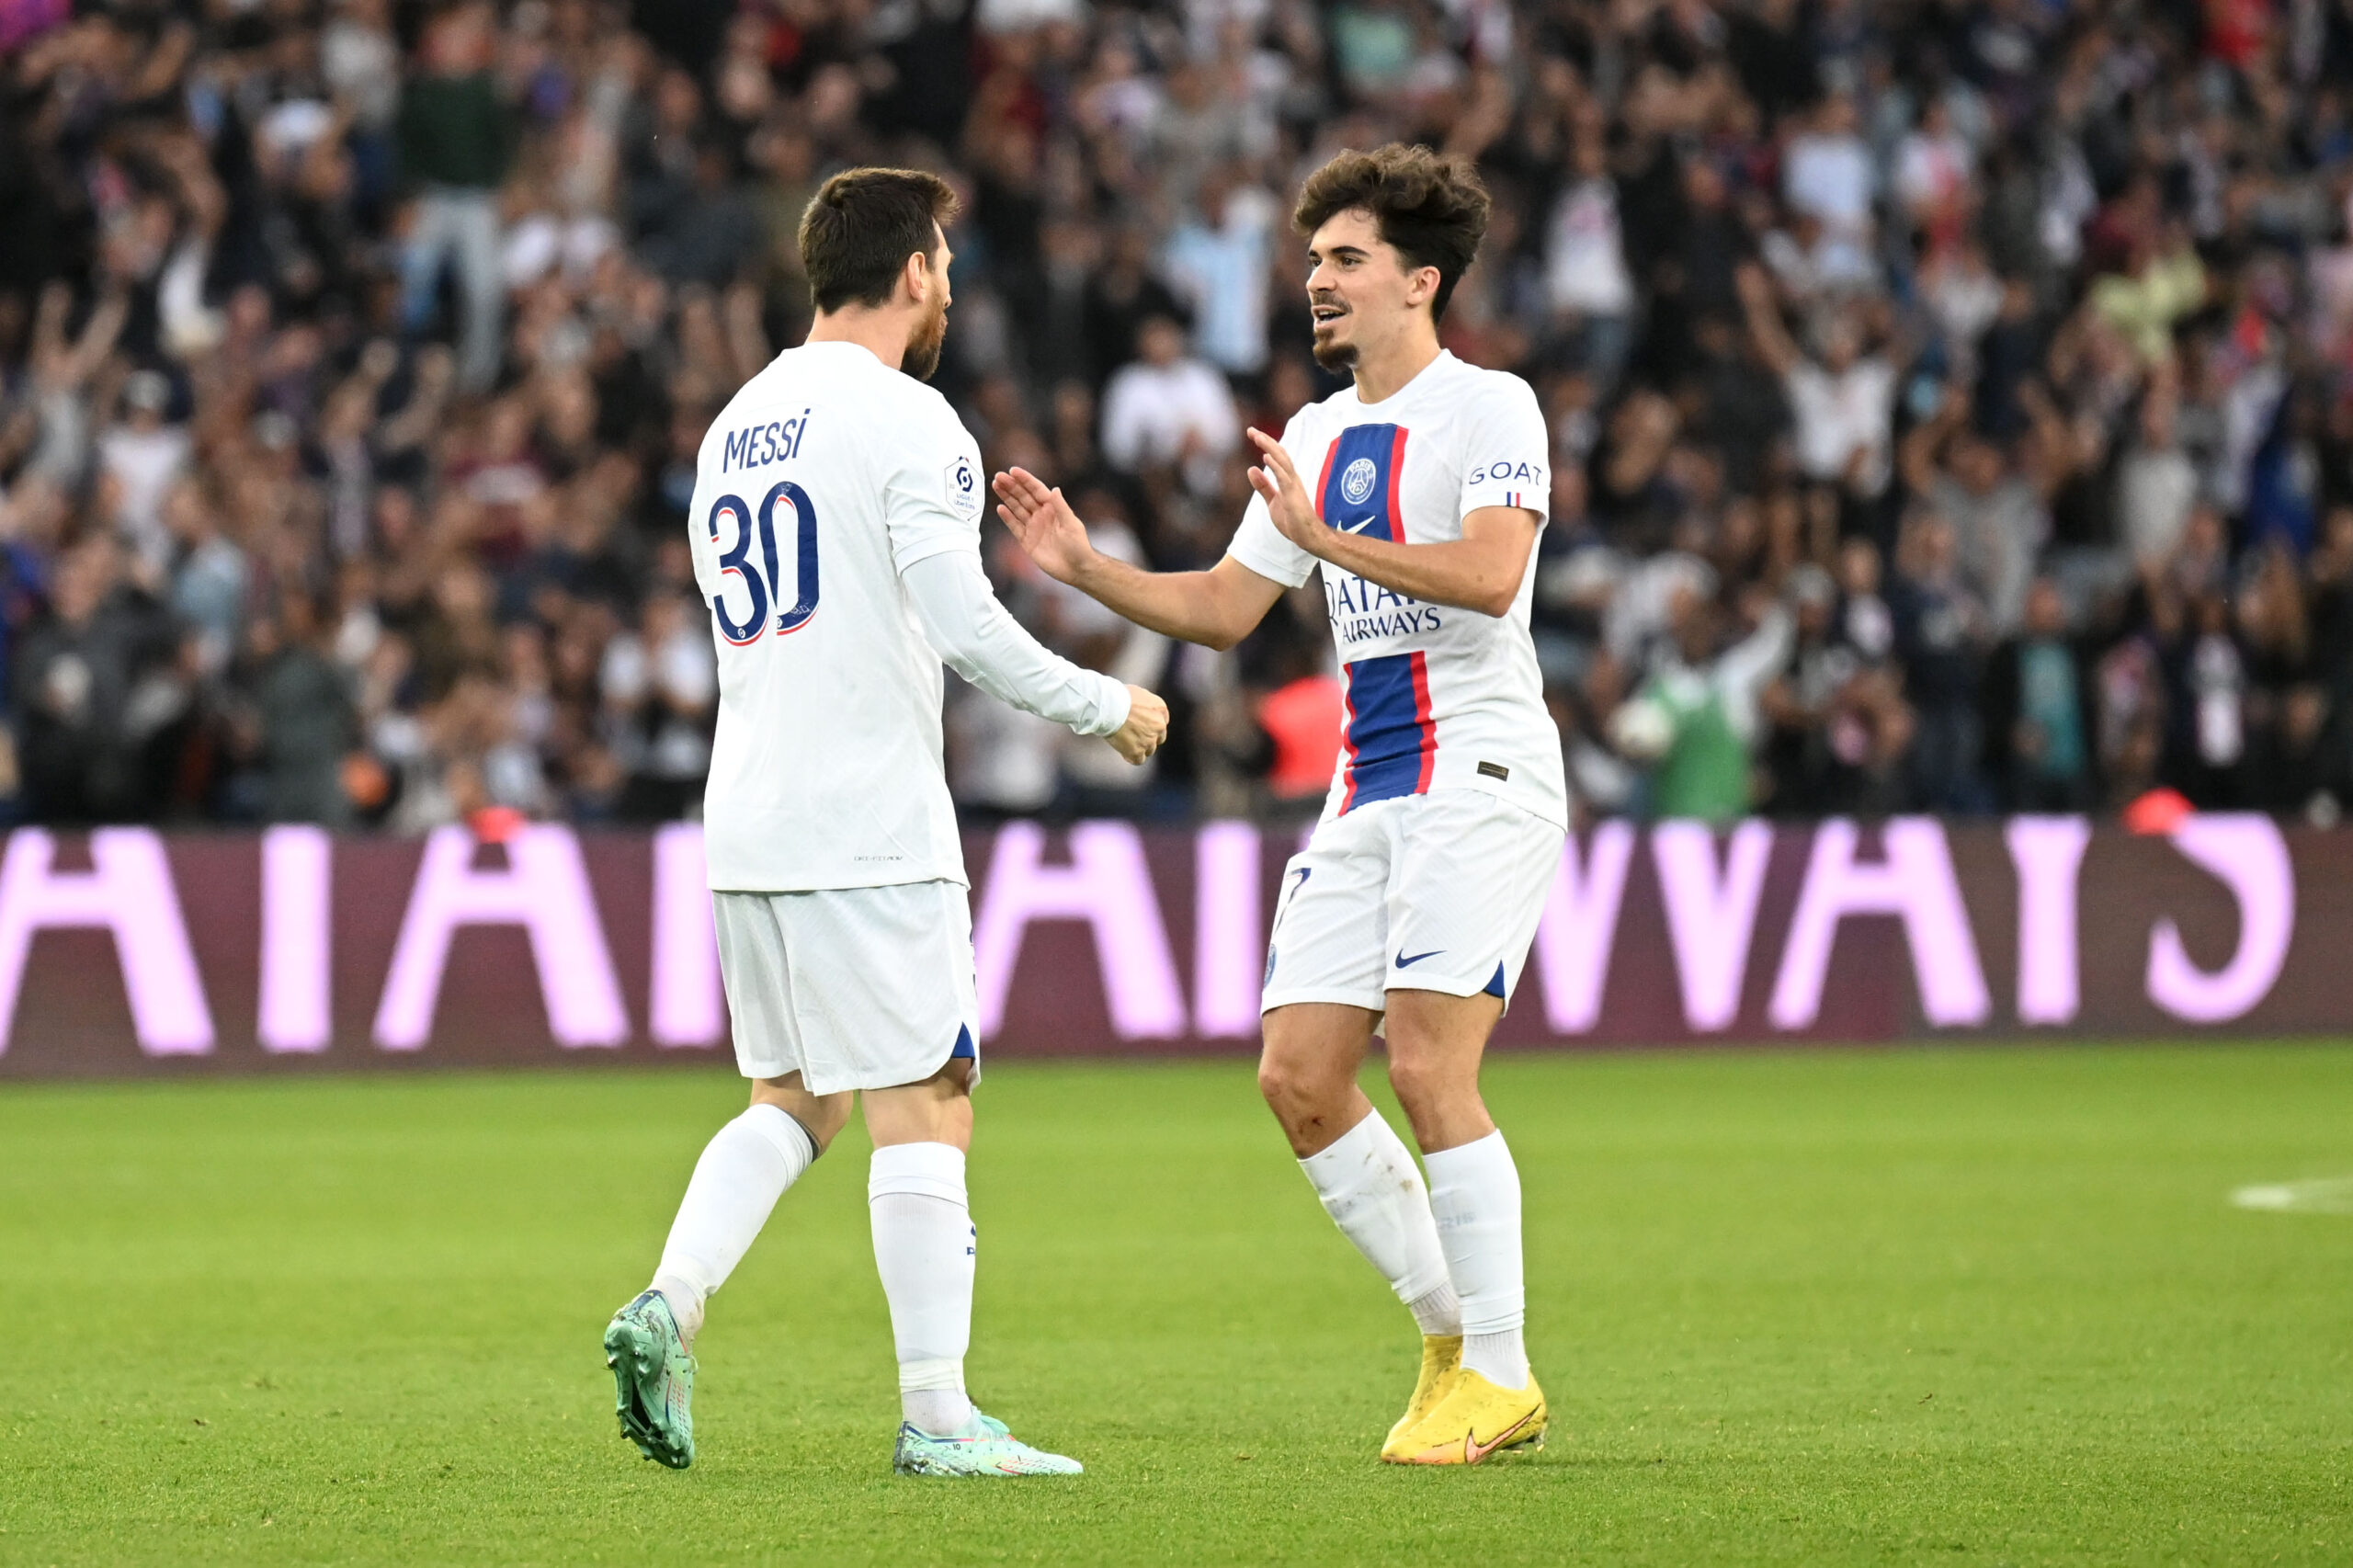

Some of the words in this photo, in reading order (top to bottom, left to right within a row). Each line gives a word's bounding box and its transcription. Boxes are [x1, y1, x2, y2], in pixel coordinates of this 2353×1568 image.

[1469, 461, 1542, 486] GOAT
[709, 481, 820, 647] 30
[1343, 607, 1441, 643] AIRWAYS
[952, 1442, 961, 1451] 10
